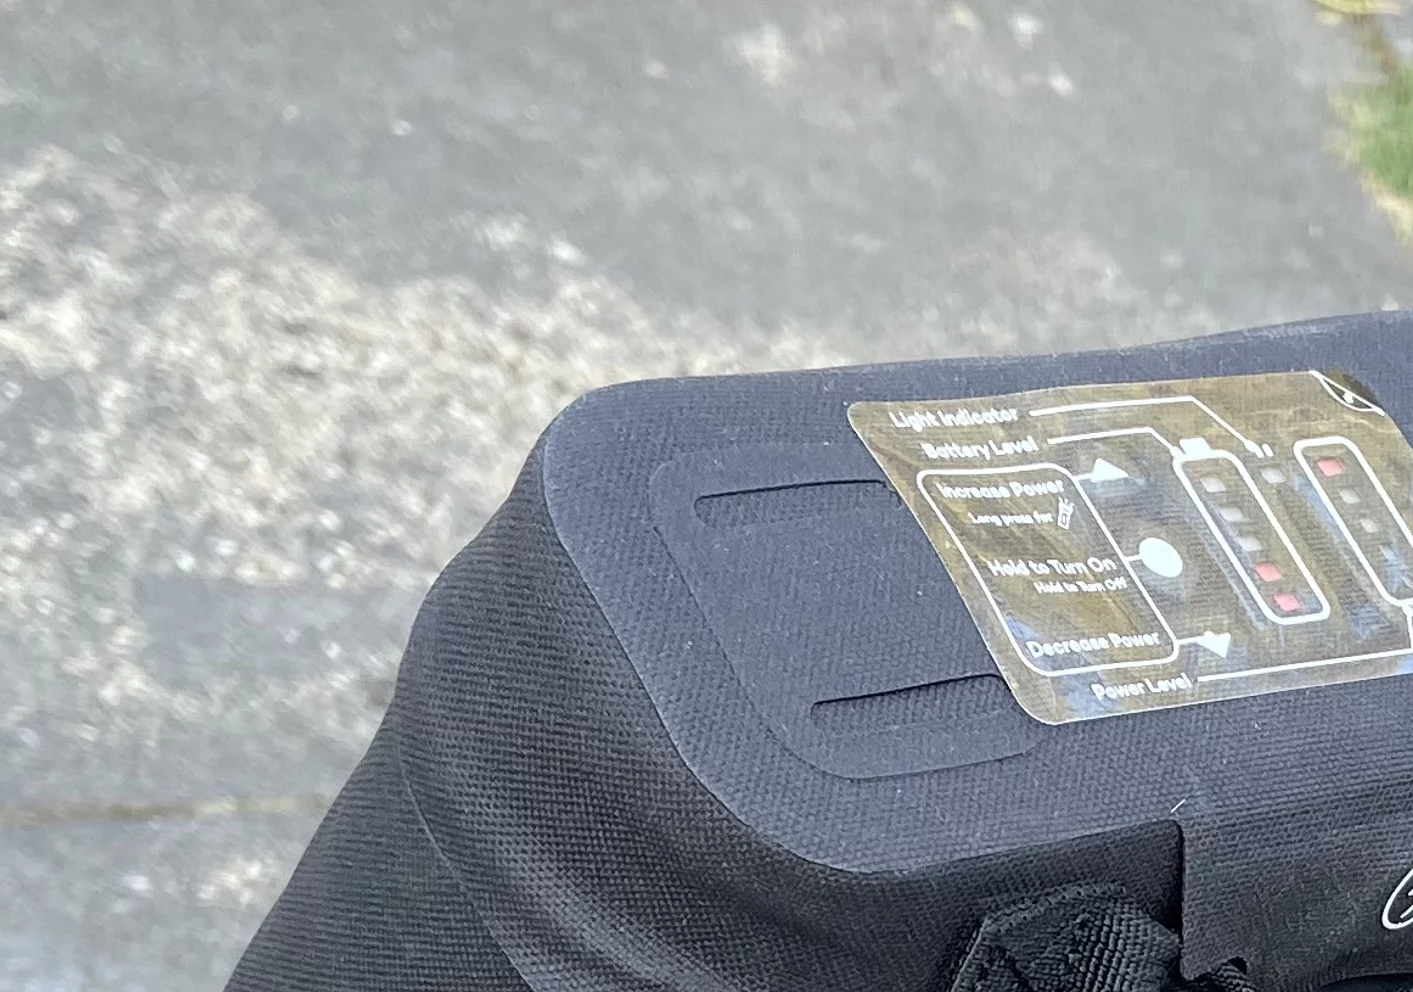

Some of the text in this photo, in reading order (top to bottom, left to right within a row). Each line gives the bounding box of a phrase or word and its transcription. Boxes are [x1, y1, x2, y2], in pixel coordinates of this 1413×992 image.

[889, 407, 1019, 432] Light Indicator
[920, 435, 1039, 460] Battery Level
[935, 480, 1064, 500] Increase Power
[986, 556, 1118, 577] Hold to Turn On
[1034, 581, 1065, 595] Hold
[1075, 581, 1104, 593] Turn
[1101, 577, 1128, 592] Off
[1026, 632, 1161, 659] Decrease Power
[1091, 673, 1194, 701] Power Level
